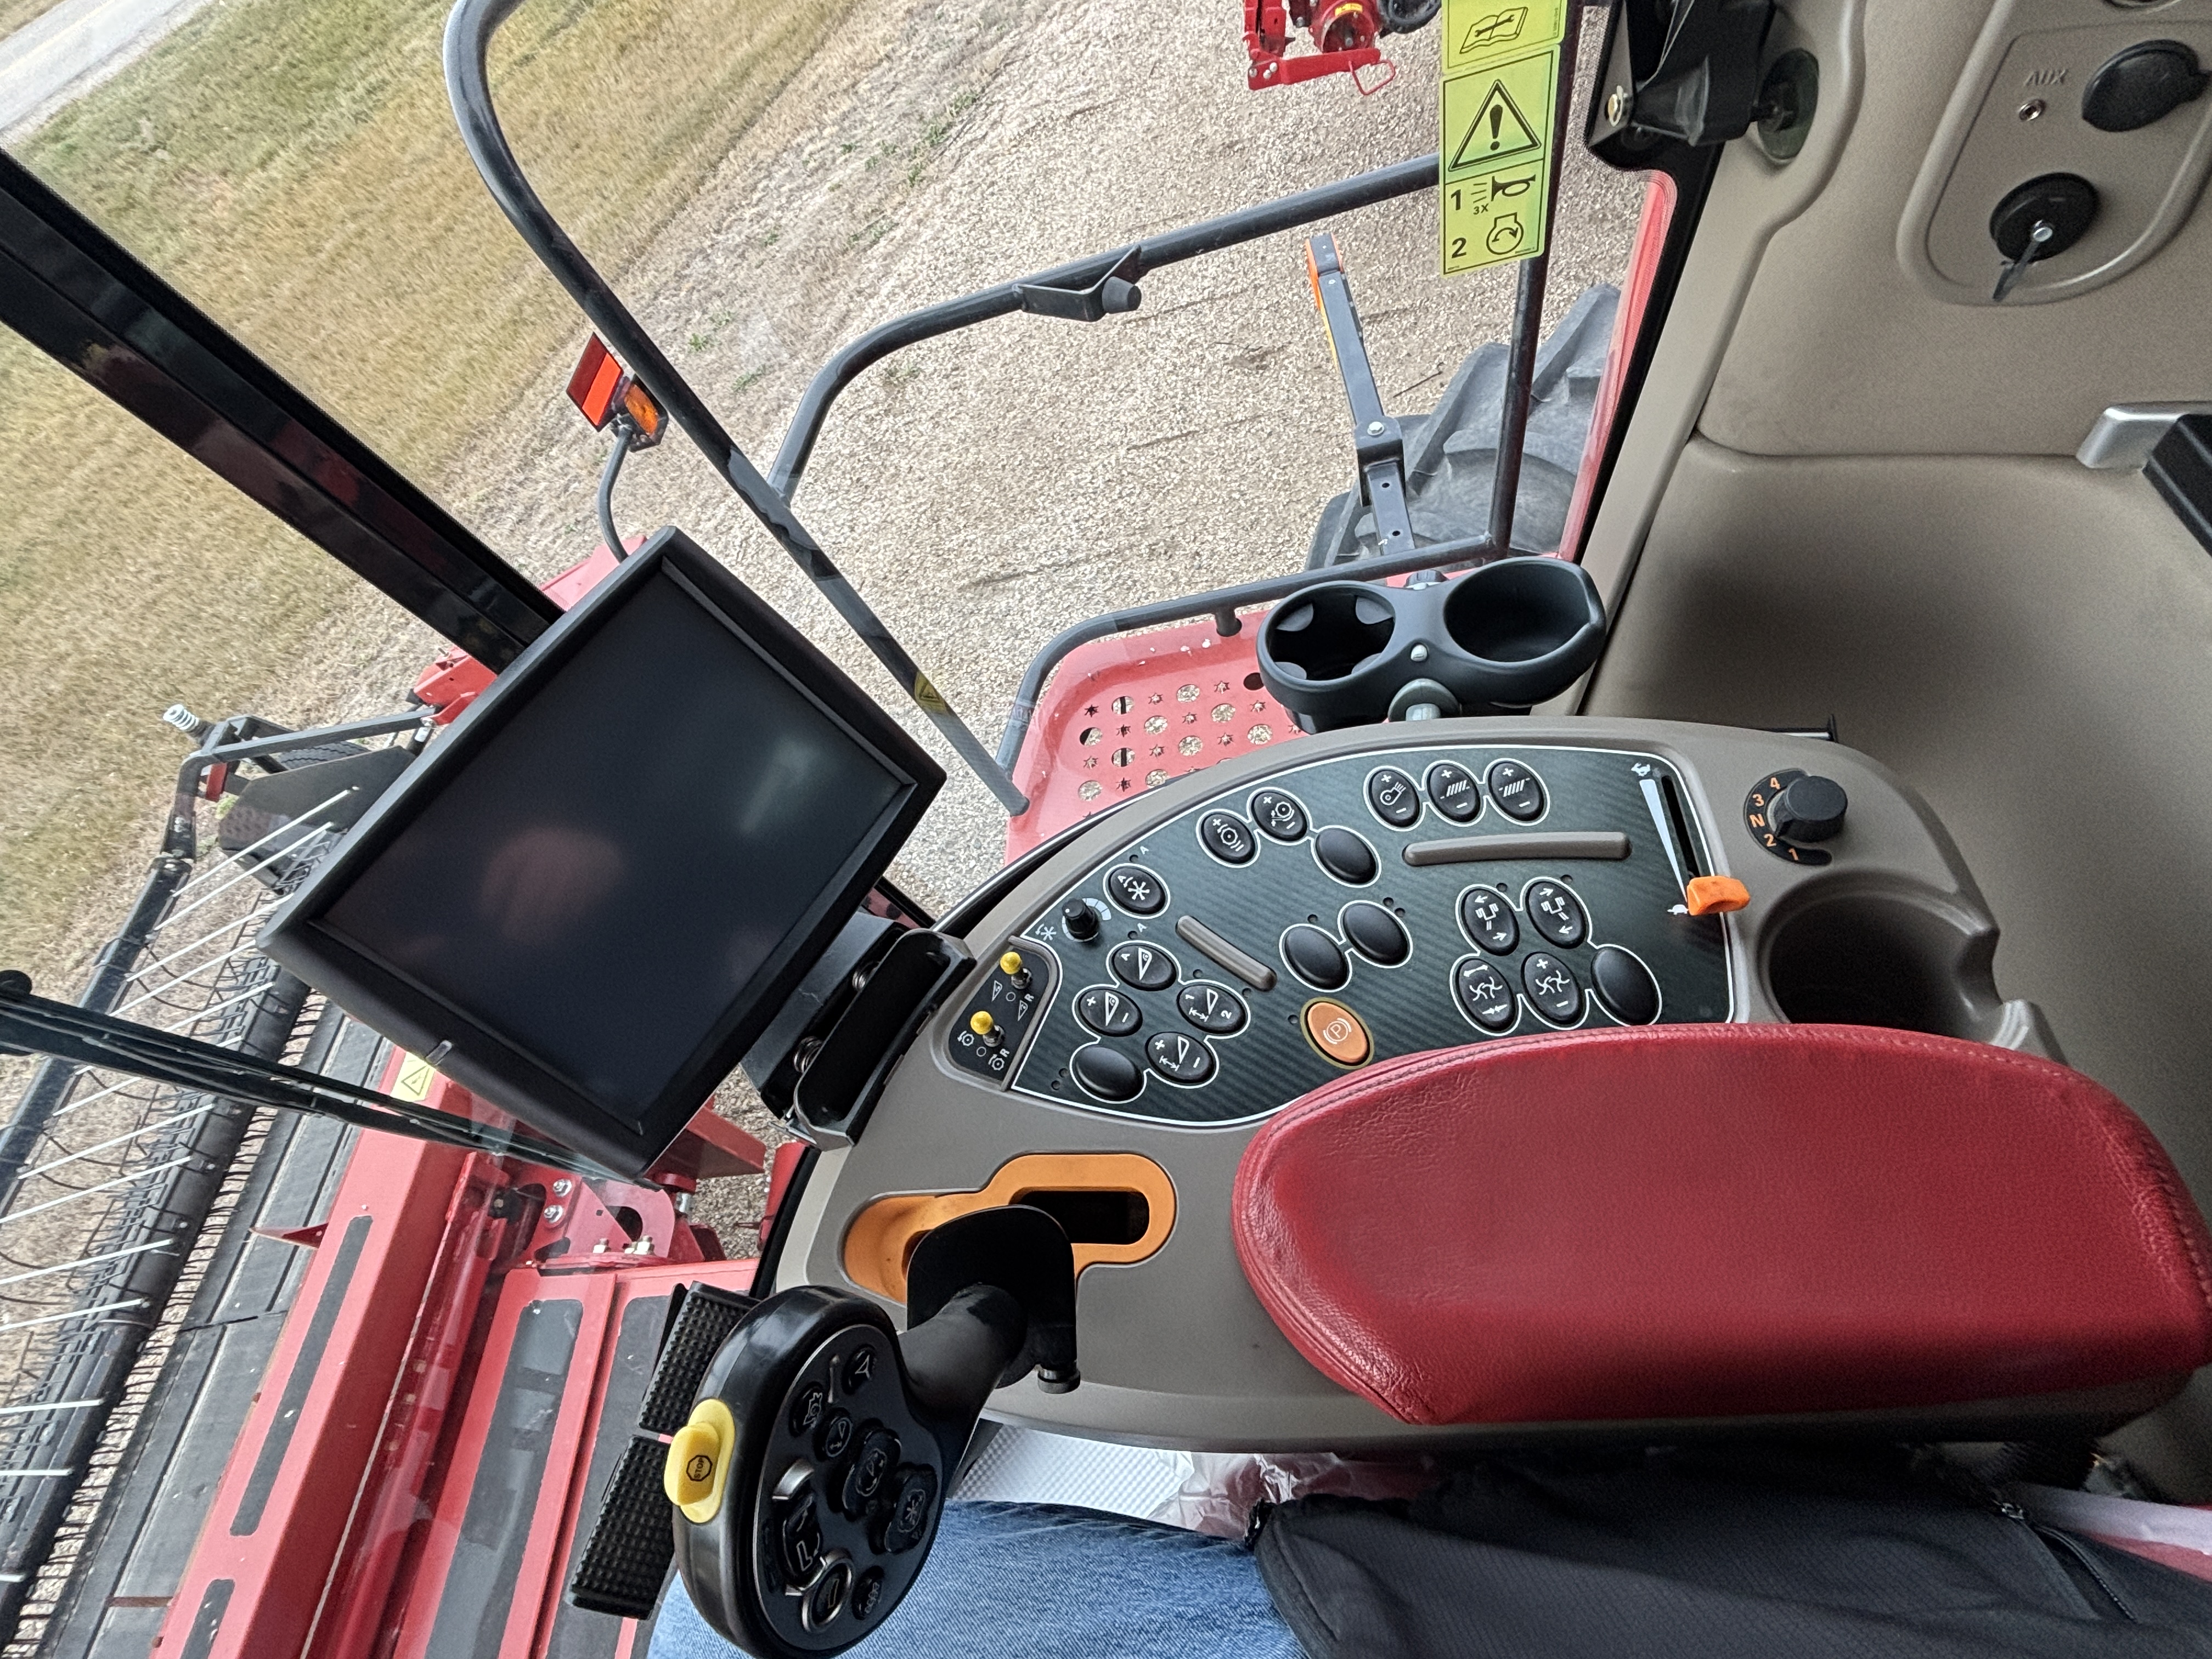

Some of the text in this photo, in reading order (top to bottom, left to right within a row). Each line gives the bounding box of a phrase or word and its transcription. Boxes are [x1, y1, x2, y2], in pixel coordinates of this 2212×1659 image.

[1451, 189, 1462, 211] 1
[1472, 203, 1489, 215] 3X
[1451, 238, 1467, 258] 2
[1770, 777, 1781, 790] 4
[1753, 794, 1764, 806] 3
[1750, 814, 1765, 828] N
[1764, 834, 1776, 847] 2
[1140, 846, 1149, 855] A
[1788, 848, 1799, 861] 1
[1118, 875, 1127, 883] A
[1137, 923, 1147, 933] A
[1024, 993, 1035, 1002] R
[1221, 1010, 1232, 1019] 2
[1330, 1024, 1342, 1039] P
[1000, 1048, 1011, 1058] R
[694, 1457, 704, 1479] STOP
